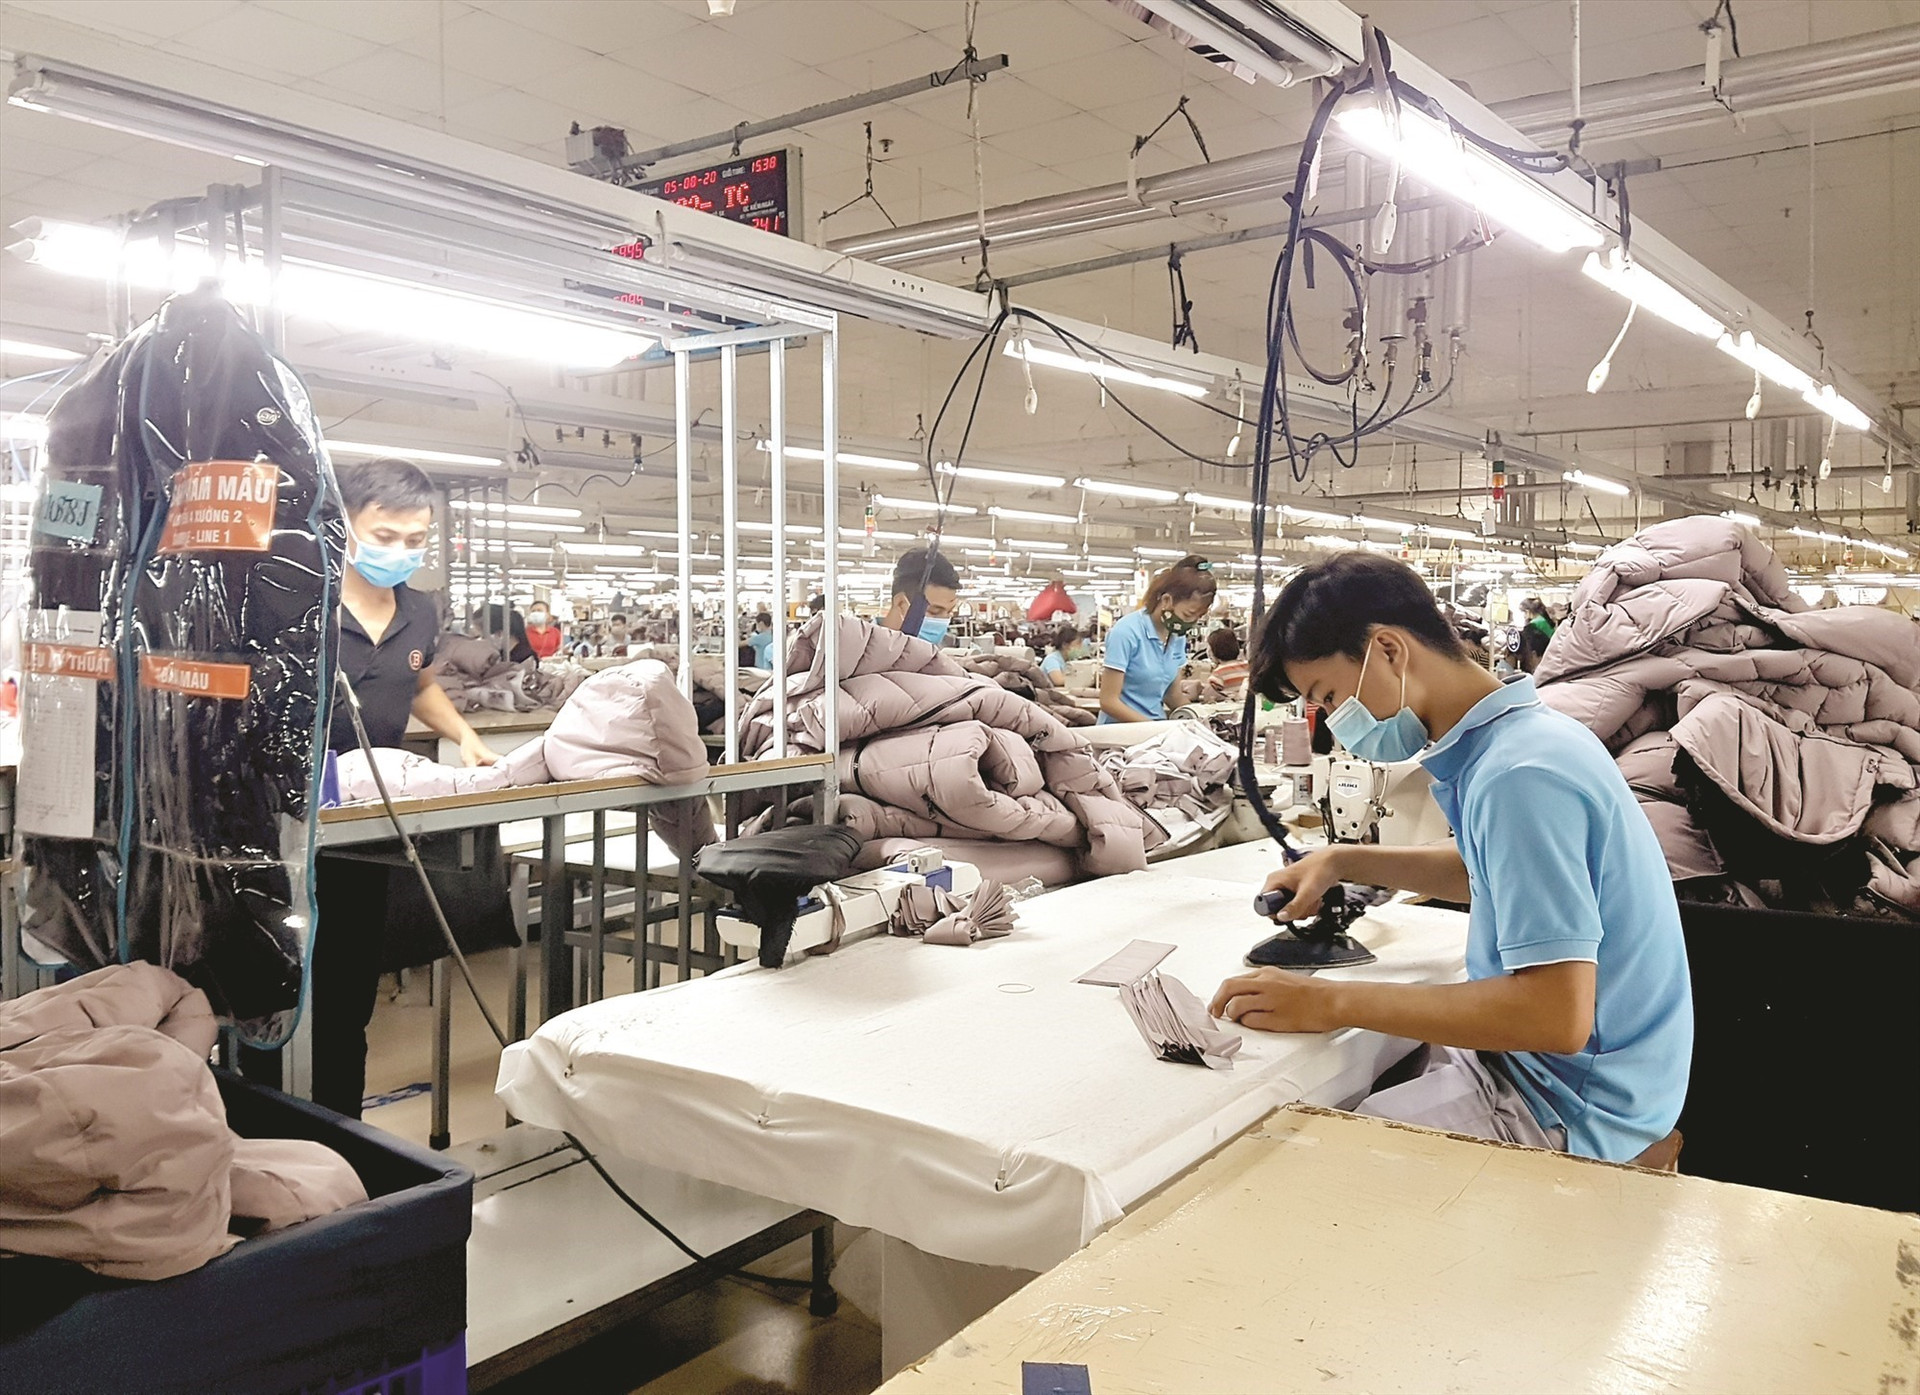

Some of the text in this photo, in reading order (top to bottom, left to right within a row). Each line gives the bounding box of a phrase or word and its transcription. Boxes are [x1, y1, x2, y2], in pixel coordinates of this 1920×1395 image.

[724, 183, 749, 208] TC
[217, 467, 273, 503] MẪU
[232, 510, 243, 523] 2
[196, 530, 220, 543] LINE
[223, 530, 230, 543] 1
[180, 667, 209, 690] MÀU
